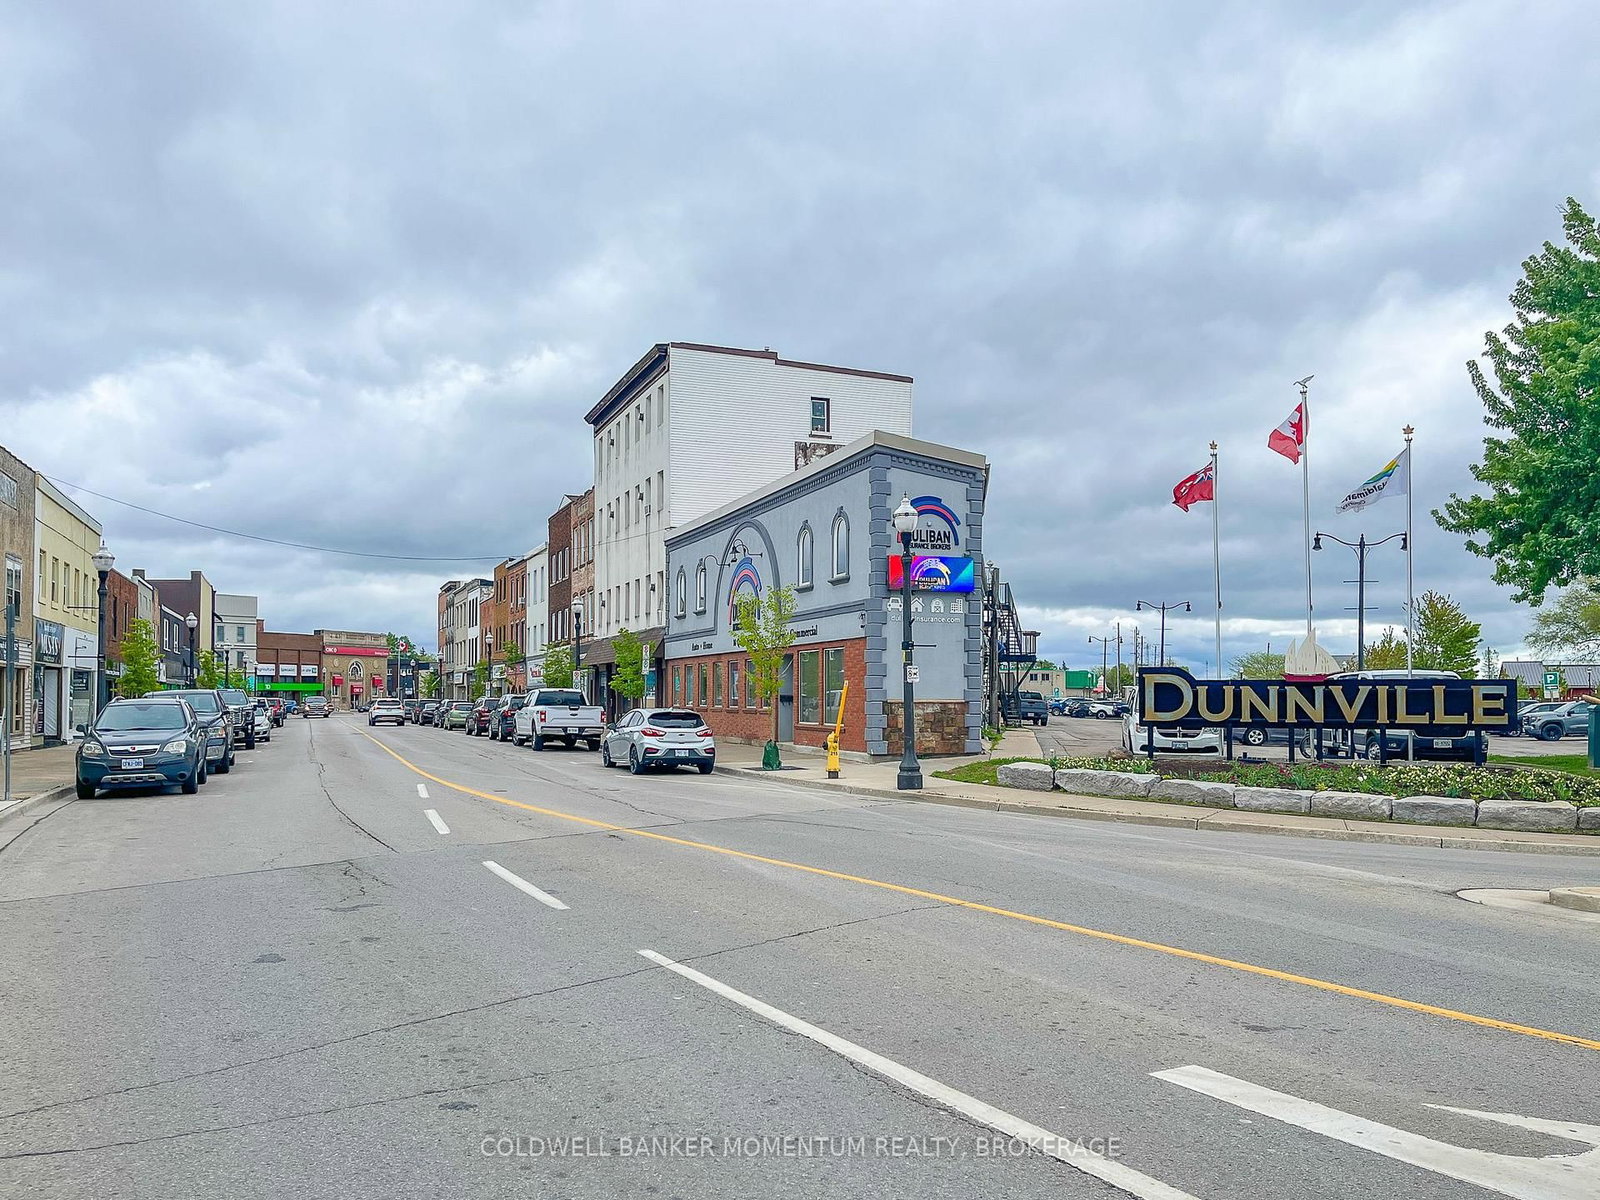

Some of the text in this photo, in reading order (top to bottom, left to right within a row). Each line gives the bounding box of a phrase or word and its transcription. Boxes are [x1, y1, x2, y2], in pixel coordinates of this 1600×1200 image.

[911, 529, 951, 544] ULIBAN
[910, 542, 952, 551] SURANCE BROKERS
[1546, 674, 1555, 684] P
[1142, 673, 1509, 725] DUNNVILLE
